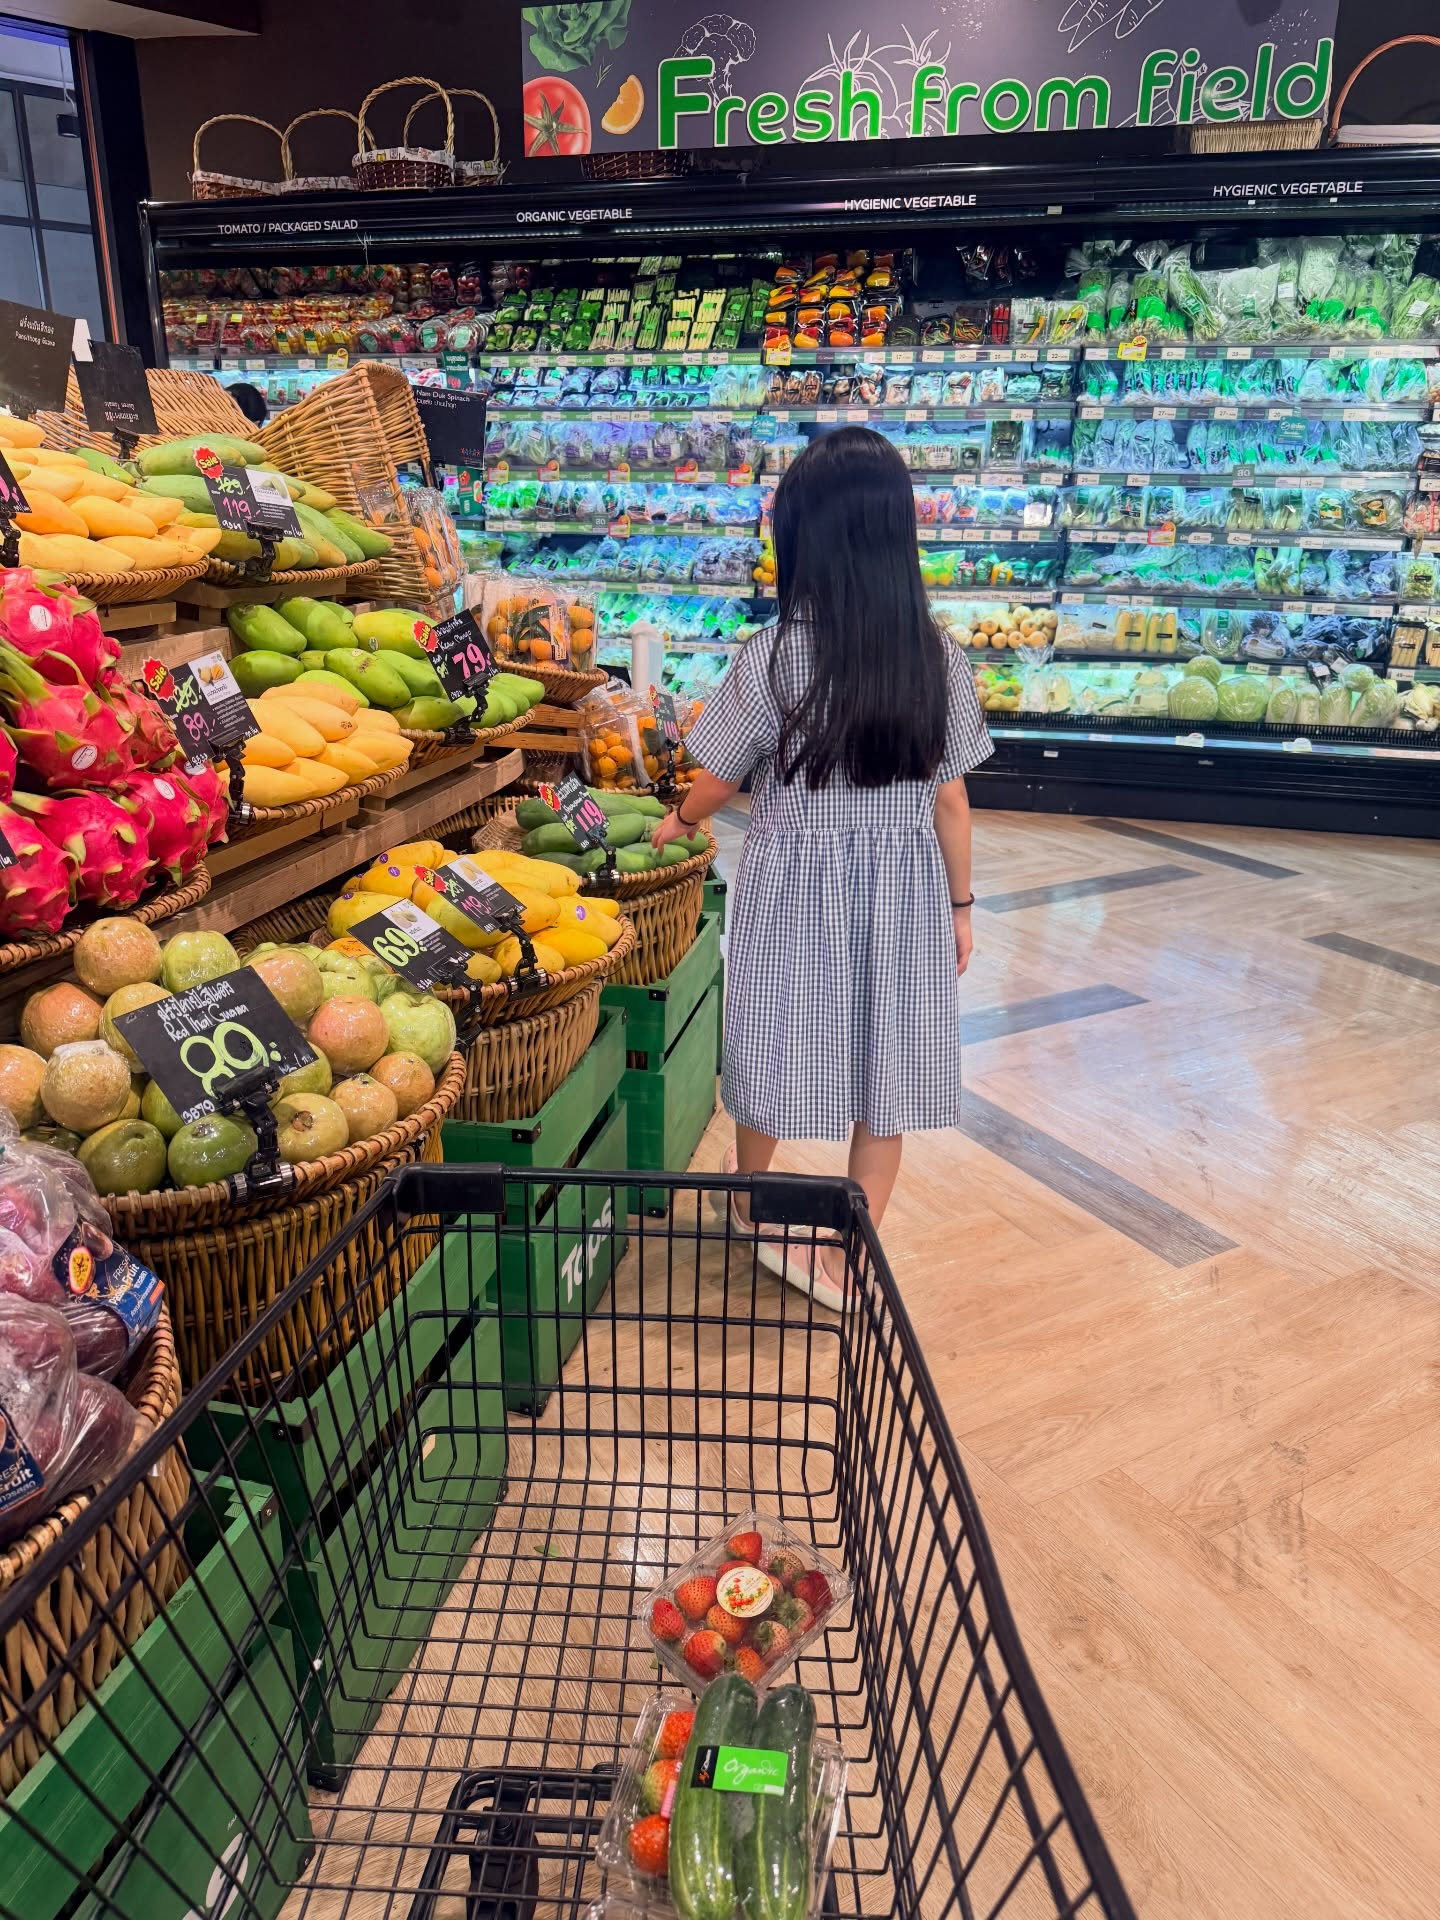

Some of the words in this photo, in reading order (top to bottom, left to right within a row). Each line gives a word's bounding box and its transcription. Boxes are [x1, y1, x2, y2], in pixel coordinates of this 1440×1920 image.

[656, 57, 882, 150] Fresh
[910, 63, 1111, 138] from
[1136, 37, 1334, 125] field
[1213, 184, 1284, 197] HYGIENIC
[1287, 181, 1363, 195] VEGETABLE
[844, 198, 902, 211] HYGIENIC
[903, 195, 977, 209] VEGETABLE
[516, 211, 566, 222] ORGANIC
[567, 208, 633, 221] VEGETABLE
[218, 224, 261, 234] TOMATO
[269, 222, 322, 232] PACKAGED
[323, 220, 358, 231] SALAD
[416, 389, 431, 398] Nam
[447, 393, 470, 404] Spinach
[198, 456, 219, 469] Sale
[420, 624, 431, 646] Sale
[149, 666, 167, 692] Sale
[164, 1016, 190, 1042] Red
[184, 1011, 212, 1035] Thai
[182, 1099, 215, 1124] 3879
[113, 1254, 131, 1280] FRESH
[122, 1263, 140, 1286] Fruit
[724, 1758, 779, 1785] Organic
